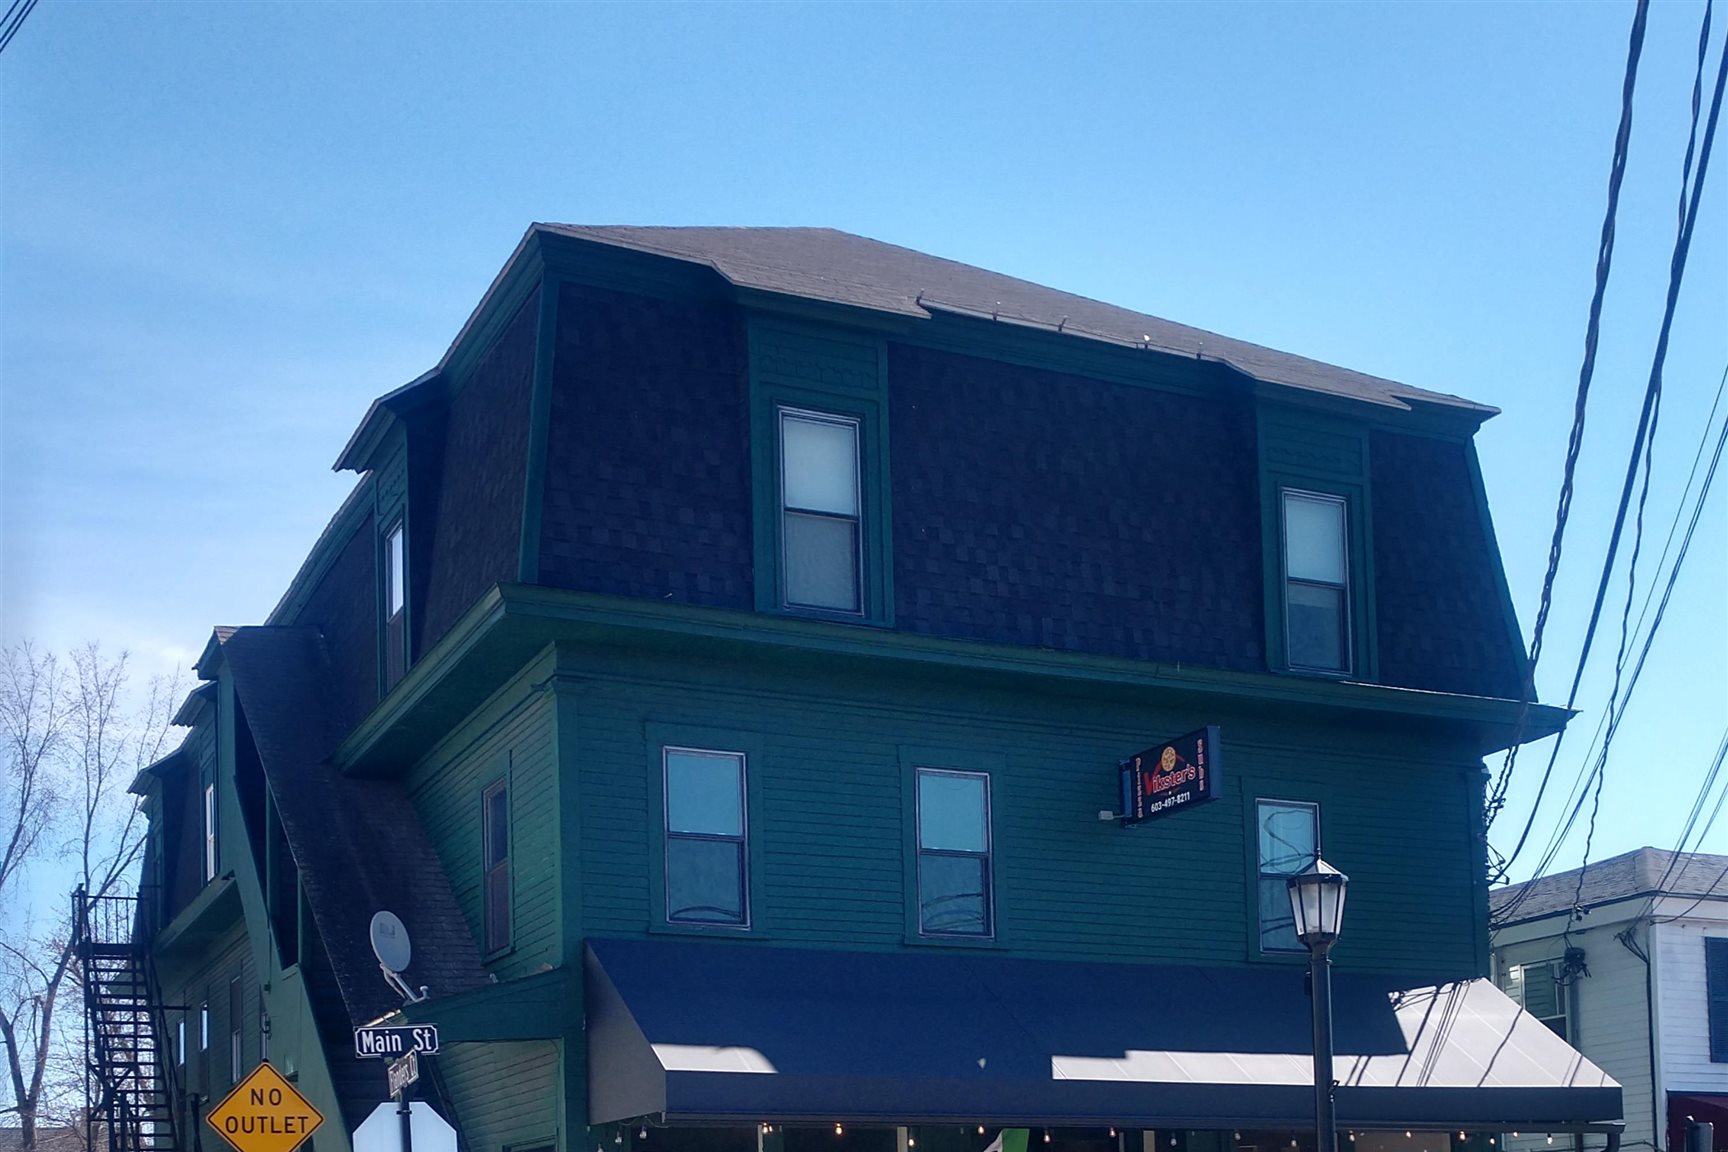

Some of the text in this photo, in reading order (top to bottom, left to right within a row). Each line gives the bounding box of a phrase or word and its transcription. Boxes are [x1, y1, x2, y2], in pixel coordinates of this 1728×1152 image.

[1144, 762, 1196, 796] Vikster's
[1151, 791, 1190, 812] 603-497-8211
[361, 1028, 432, 1053] Main St
[251, 1088, 282, 1106] NO
[225, 1116, 309, 1134] OUTLET
